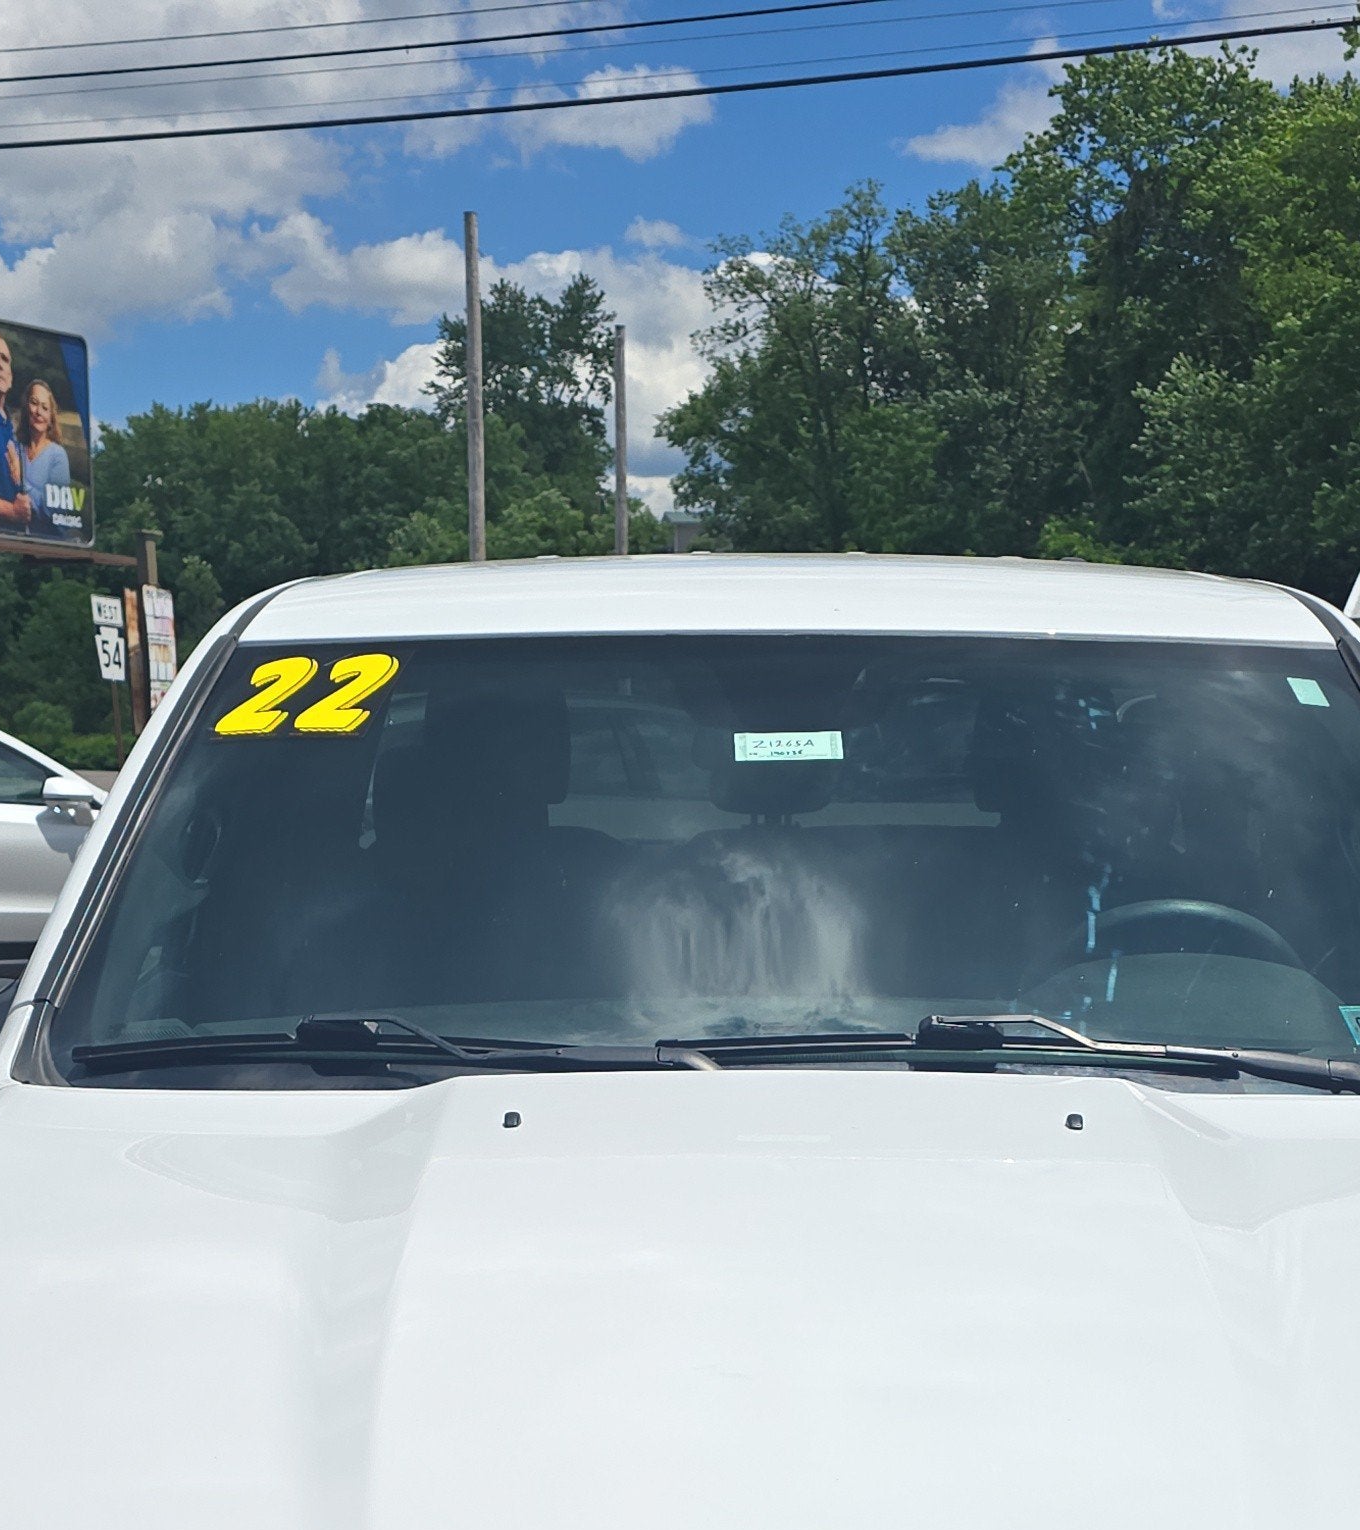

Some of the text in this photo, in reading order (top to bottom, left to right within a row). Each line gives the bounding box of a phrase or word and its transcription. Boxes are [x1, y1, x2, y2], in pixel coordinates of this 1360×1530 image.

[45, 483, 85, 512] DAV
[96, 602, 118, 621] WEST
[101, 639, 122, 670] 54
[214, 653, 400, 735] 22
